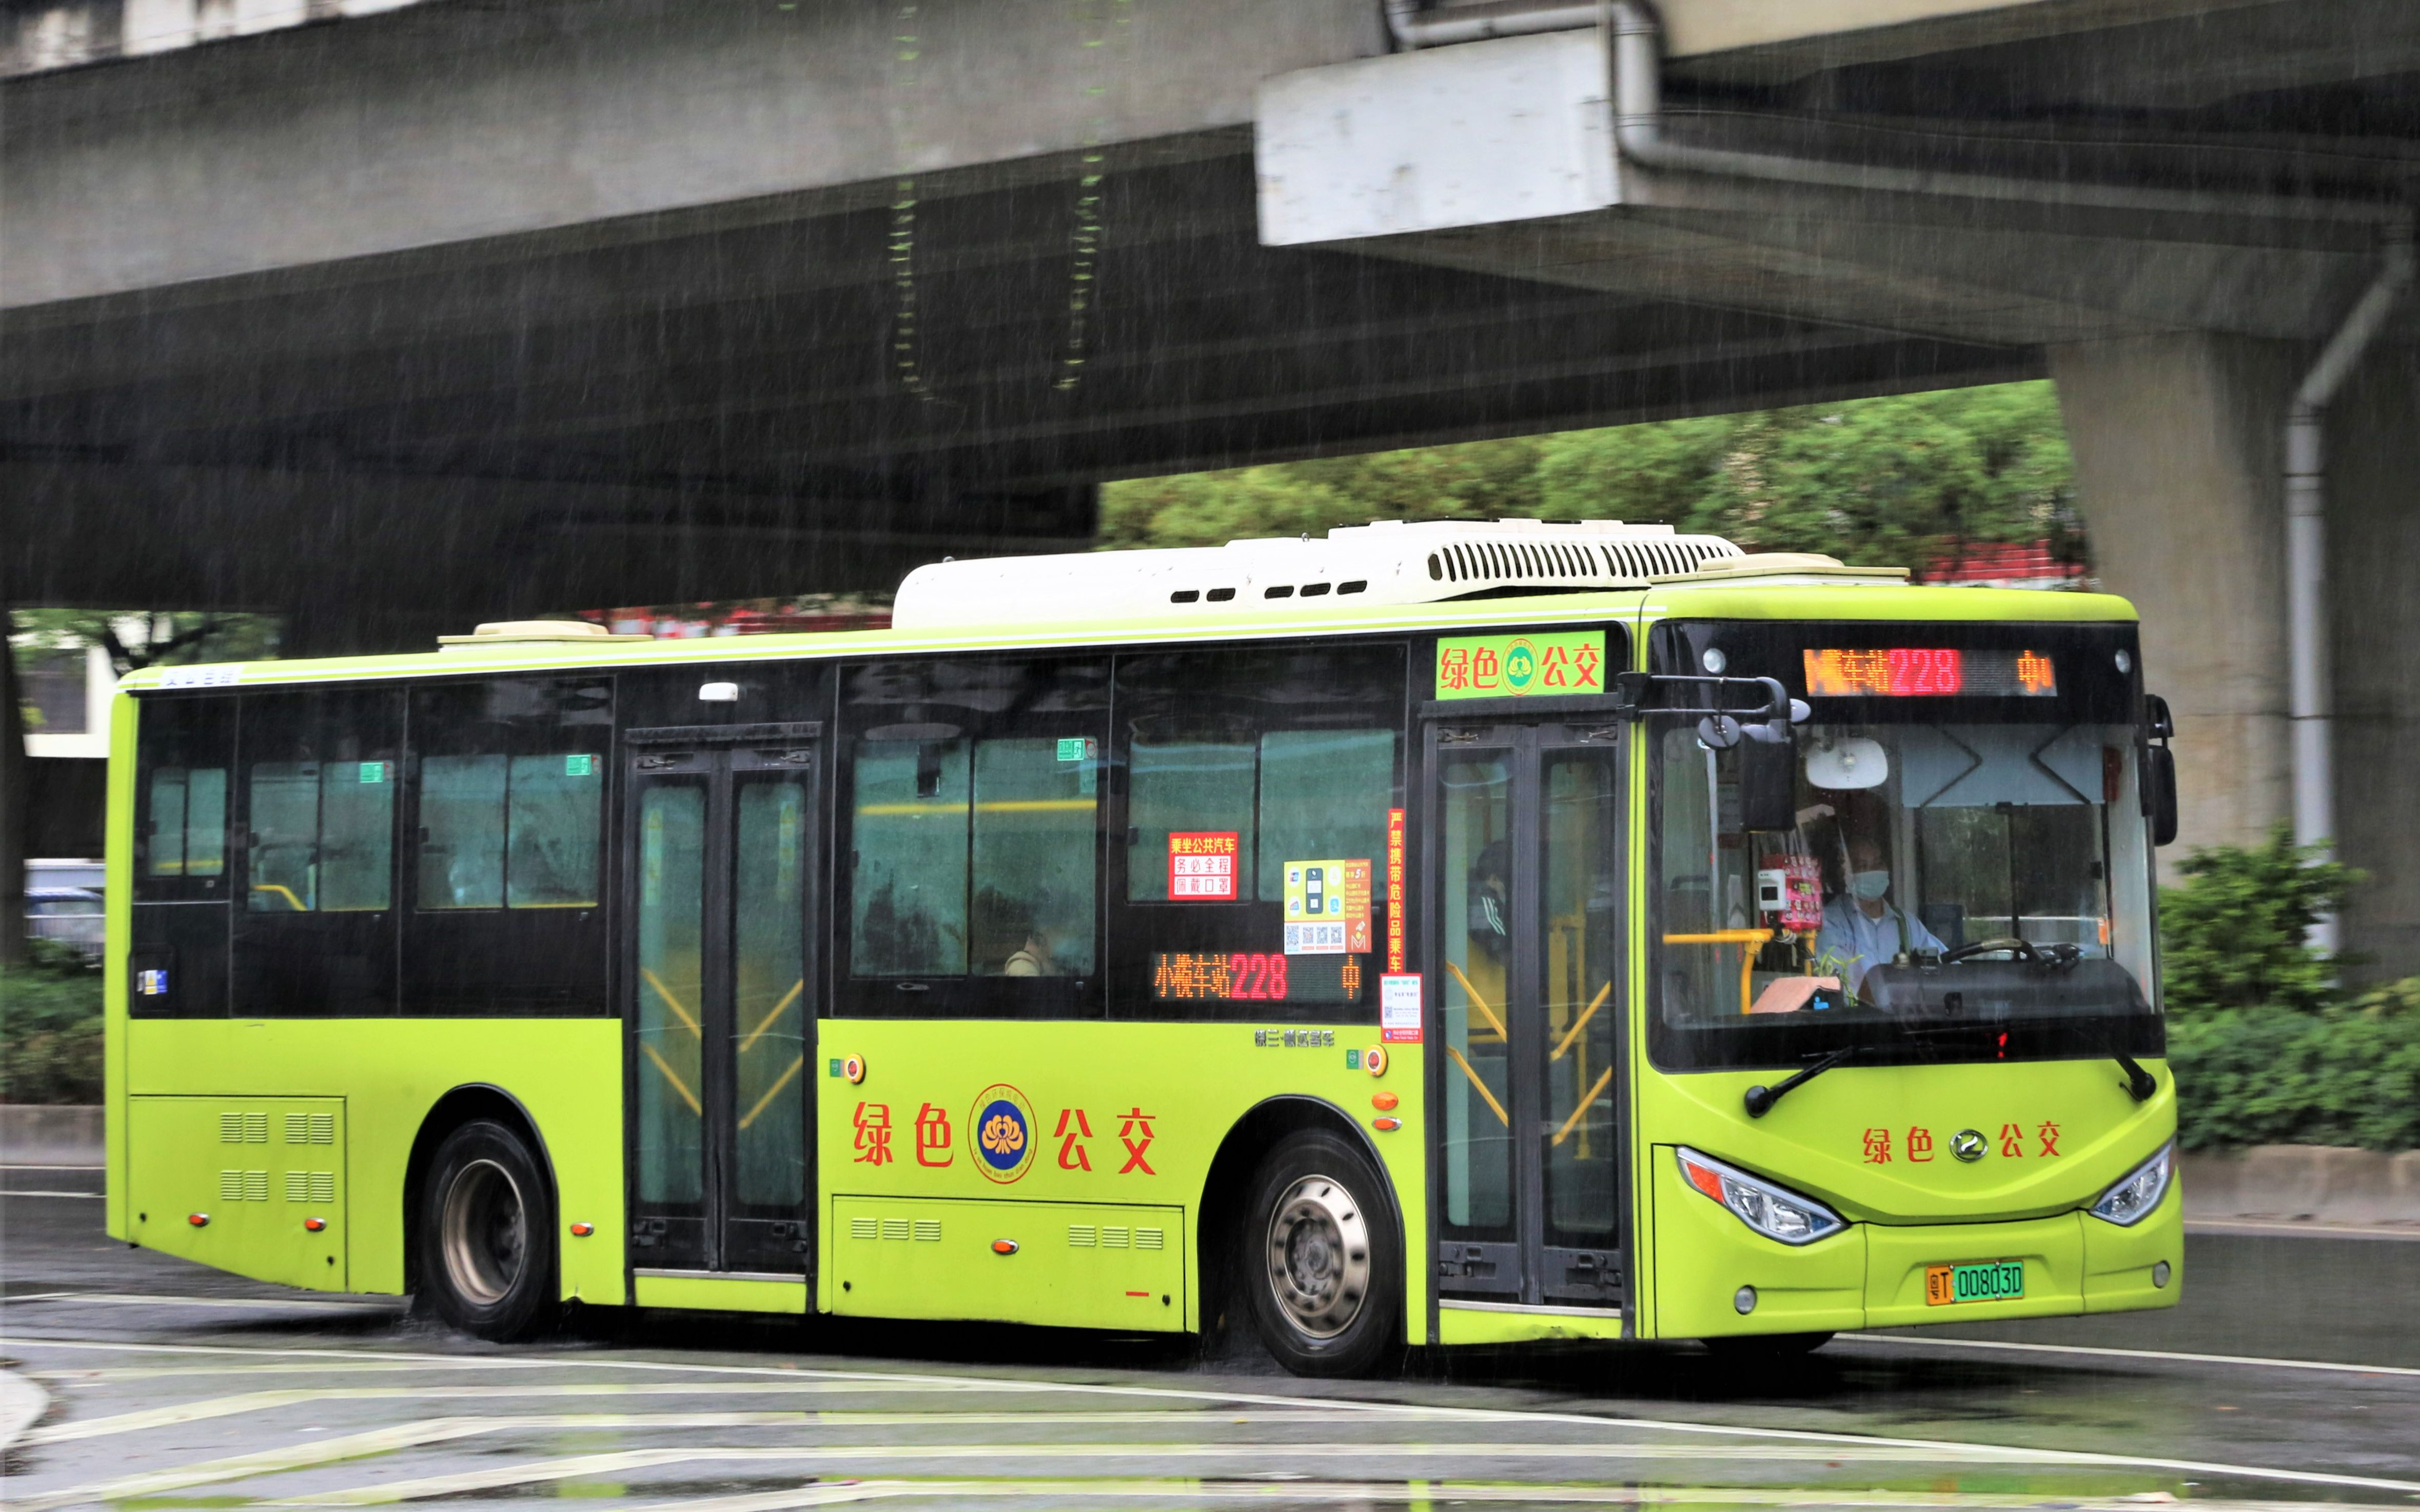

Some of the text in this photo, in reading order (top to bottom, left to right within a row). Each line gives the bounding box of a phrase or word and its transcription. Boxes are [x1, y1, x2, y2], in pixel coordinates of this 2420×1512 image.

[1441, 643, 1601, 690] 绿色 公交
[1888, 649, 1956, 692] 228
[1171, 837, 1235, 854] 乘坐公共汽车
[1176, 858, 1229, 873] 务必全程
[1176, 878, 1229, 893] 佩戴口罩
[1389, 812, 1402, 972] 严禁携带危险品乘车
[1230, 952, 1287, 1000] 228
[1342, 954, 1360, 1000] 中
[853, 1101, 1156, 1176] 绿色 公交
[1862, 1120, 2061, 1165] 绿色 公交
[1958, 1266, 2022, 1297] 00803D
